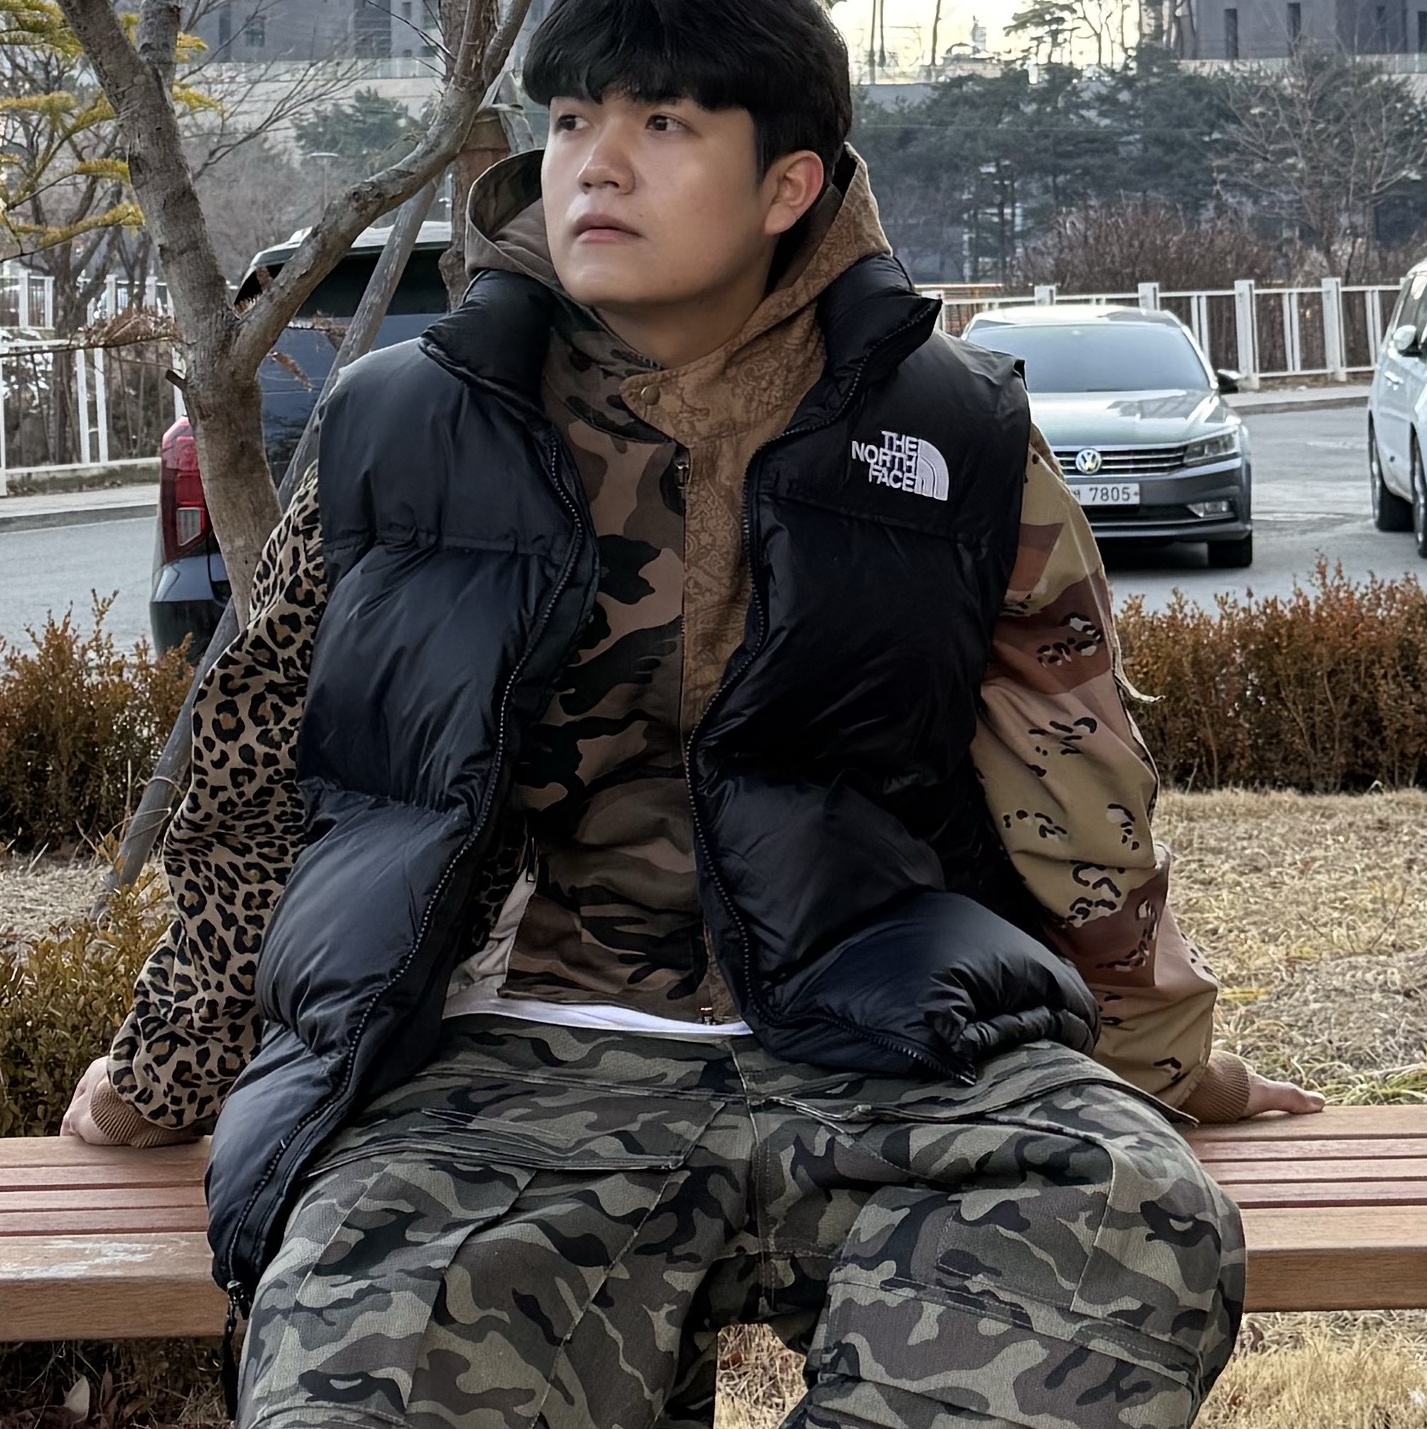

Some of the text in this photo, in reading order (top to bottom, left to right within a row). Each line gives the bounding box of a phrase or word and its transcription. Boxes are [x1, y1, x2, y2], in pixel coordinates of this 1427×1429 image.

[880, 430, 918, 456] THE
[851, 440, 917, 477] NORTH
[868, 463, 917, 493] FACE
[1089, 486, 1131, 502] 7805
